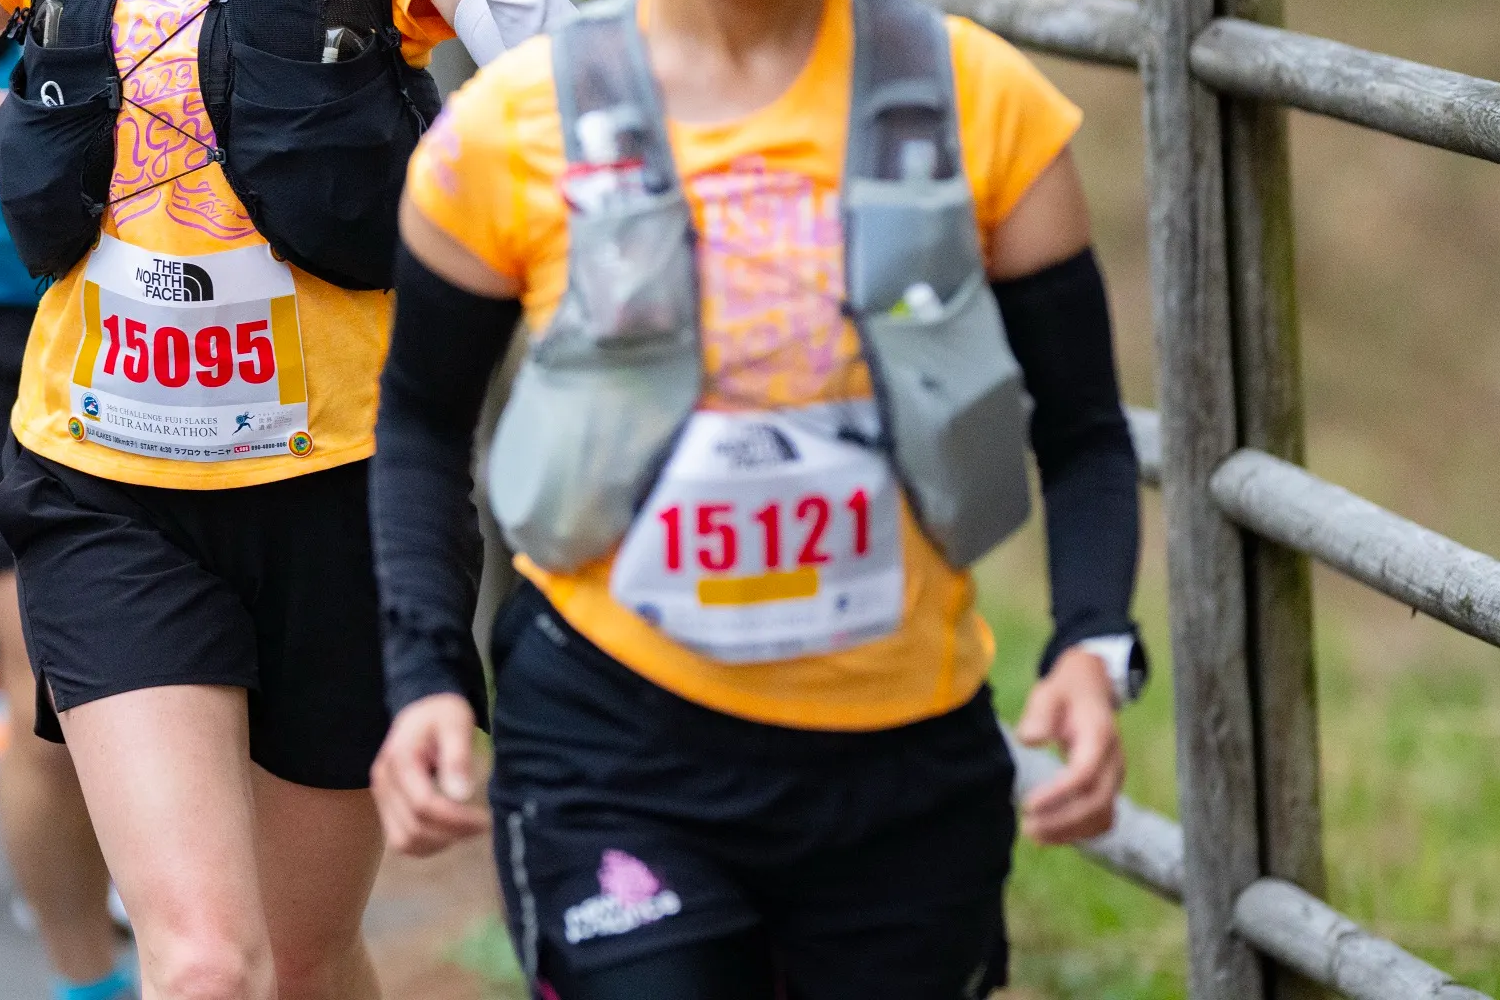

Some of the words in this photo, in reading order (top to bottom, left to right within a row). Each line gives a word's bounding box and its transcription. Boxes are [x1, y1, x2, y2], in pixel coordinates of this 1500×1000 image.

[130, 63, 193, 102] 2023
[153, 258, 182, 275] THE
[135, 267, 182, 289] NORTH
[145, 285, 182, 302] FACE
[103, 314, 276, 388] 15095
[106, 412, 219, 438] ULTRAMARATHON
[119, 407, 162, 422] CHALLENGE
[165, 416, 182, 424] FUJI
[184, 417, 218, 425] 5LAKES
[140, 443, 158, 452] START
[159, 446, 172, 454] 4:30
[657, 487, 871, 572] 15121
